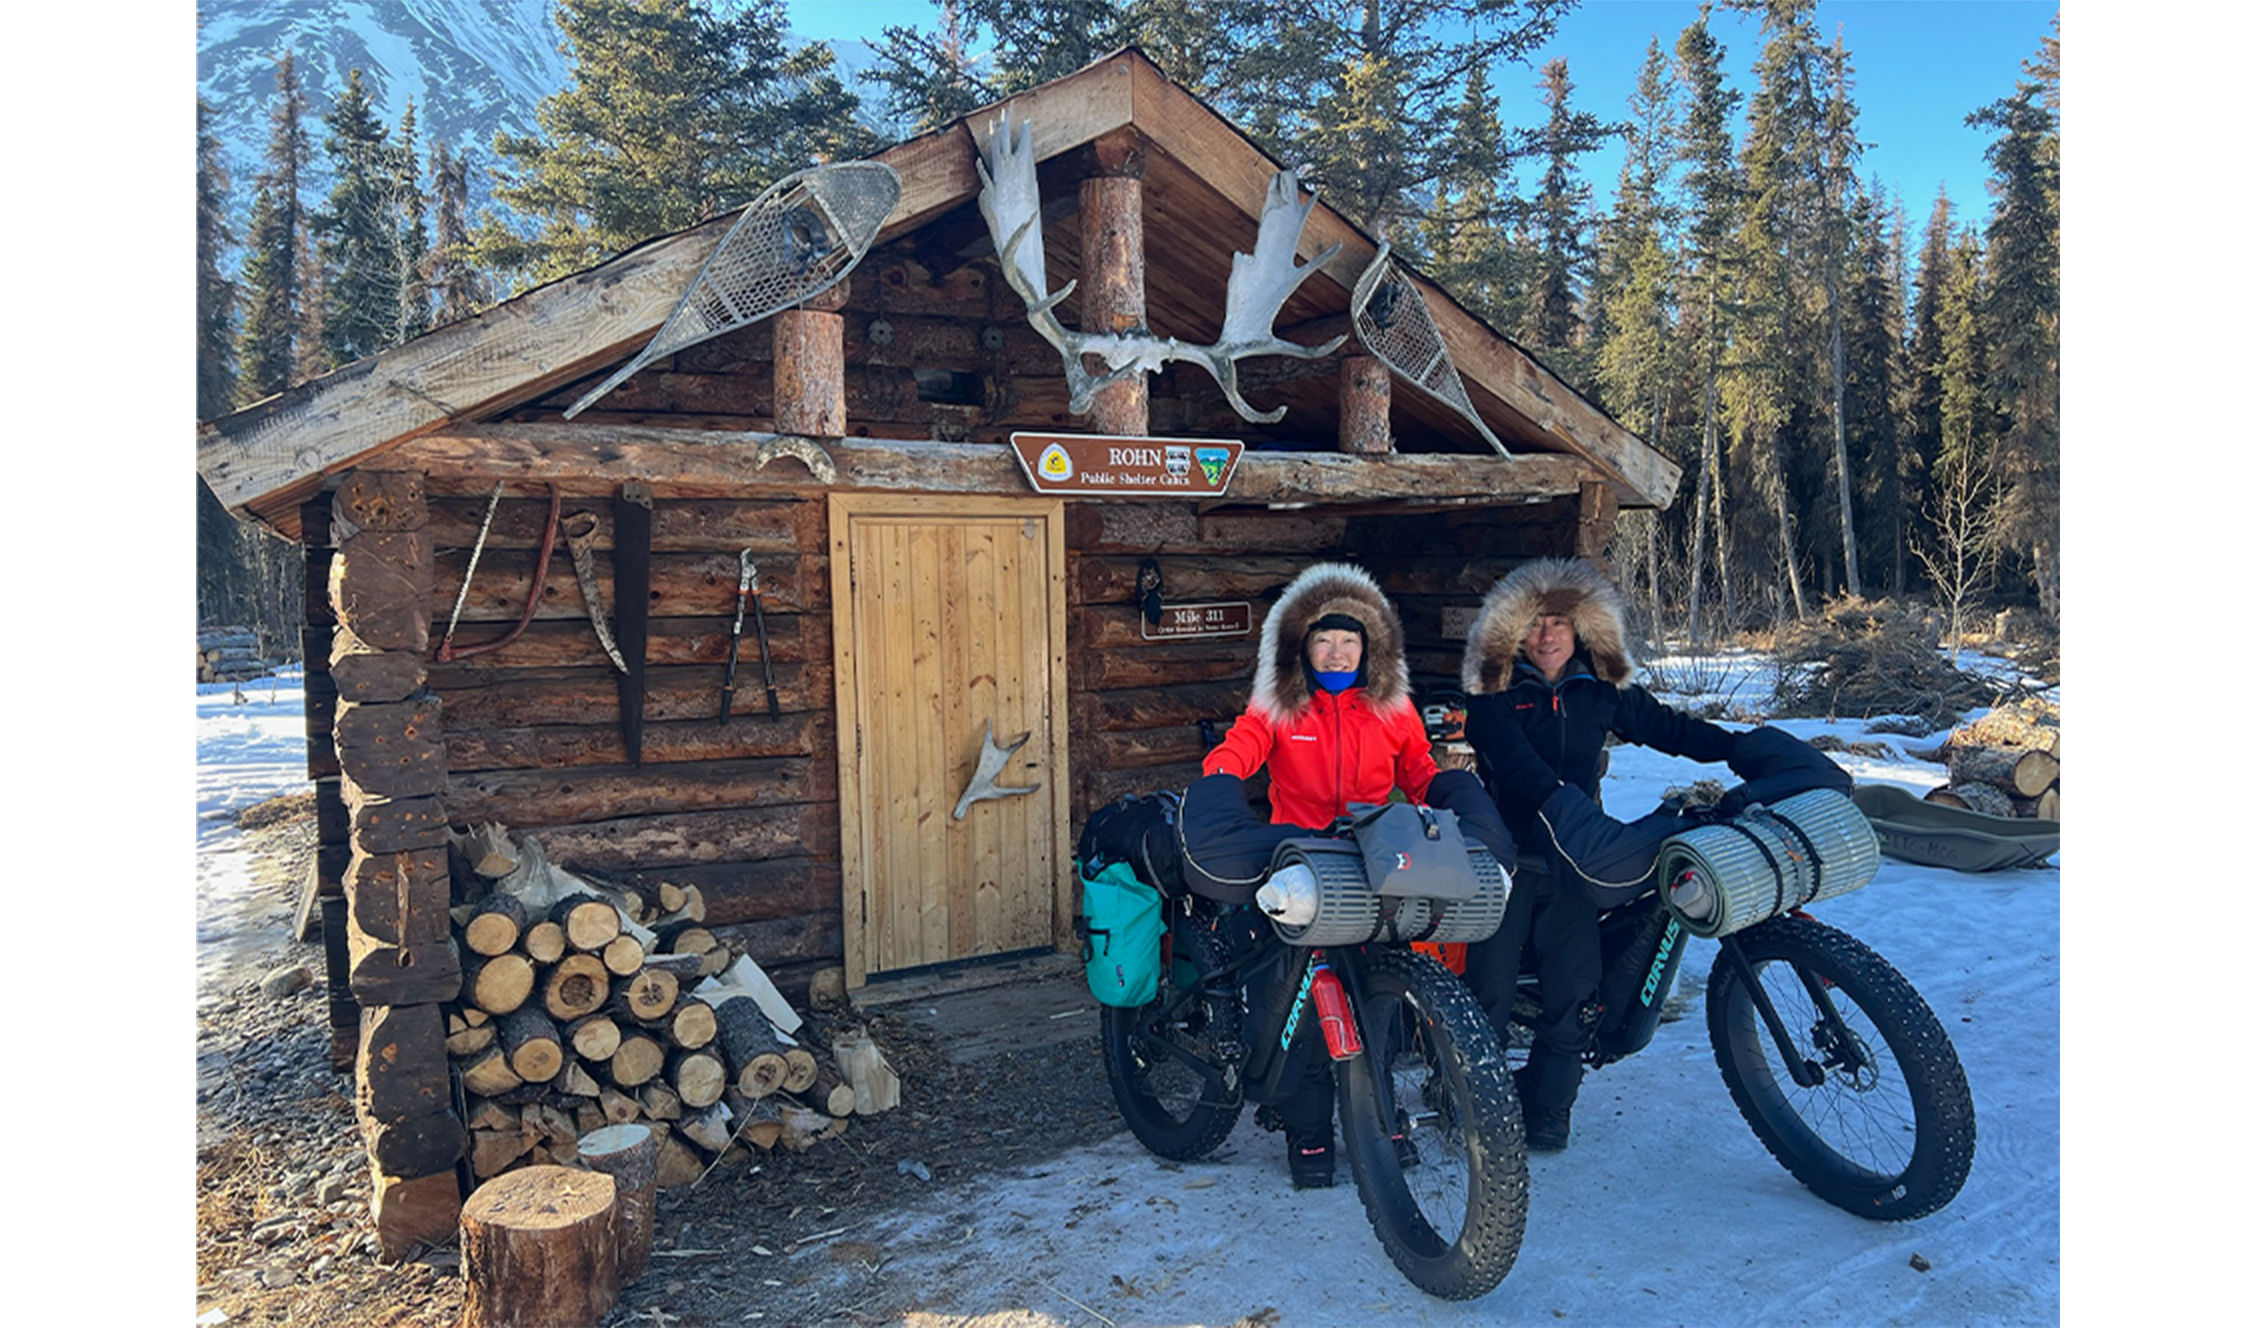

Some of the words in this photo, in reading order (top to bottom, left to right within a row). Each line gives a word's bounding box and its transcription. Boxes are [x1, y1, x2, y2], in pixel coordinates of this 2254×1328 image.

[1109, 447, 1162, 466] ROHN
[1080, 471, 1115, 484] Public
[1119, 472, 1157, 485] Shelter
[1174, 610, 1201, 624] Mile
[1205, 609, 1224, 622] 311
[1640, 916, 1681, 1007] CORVUS
